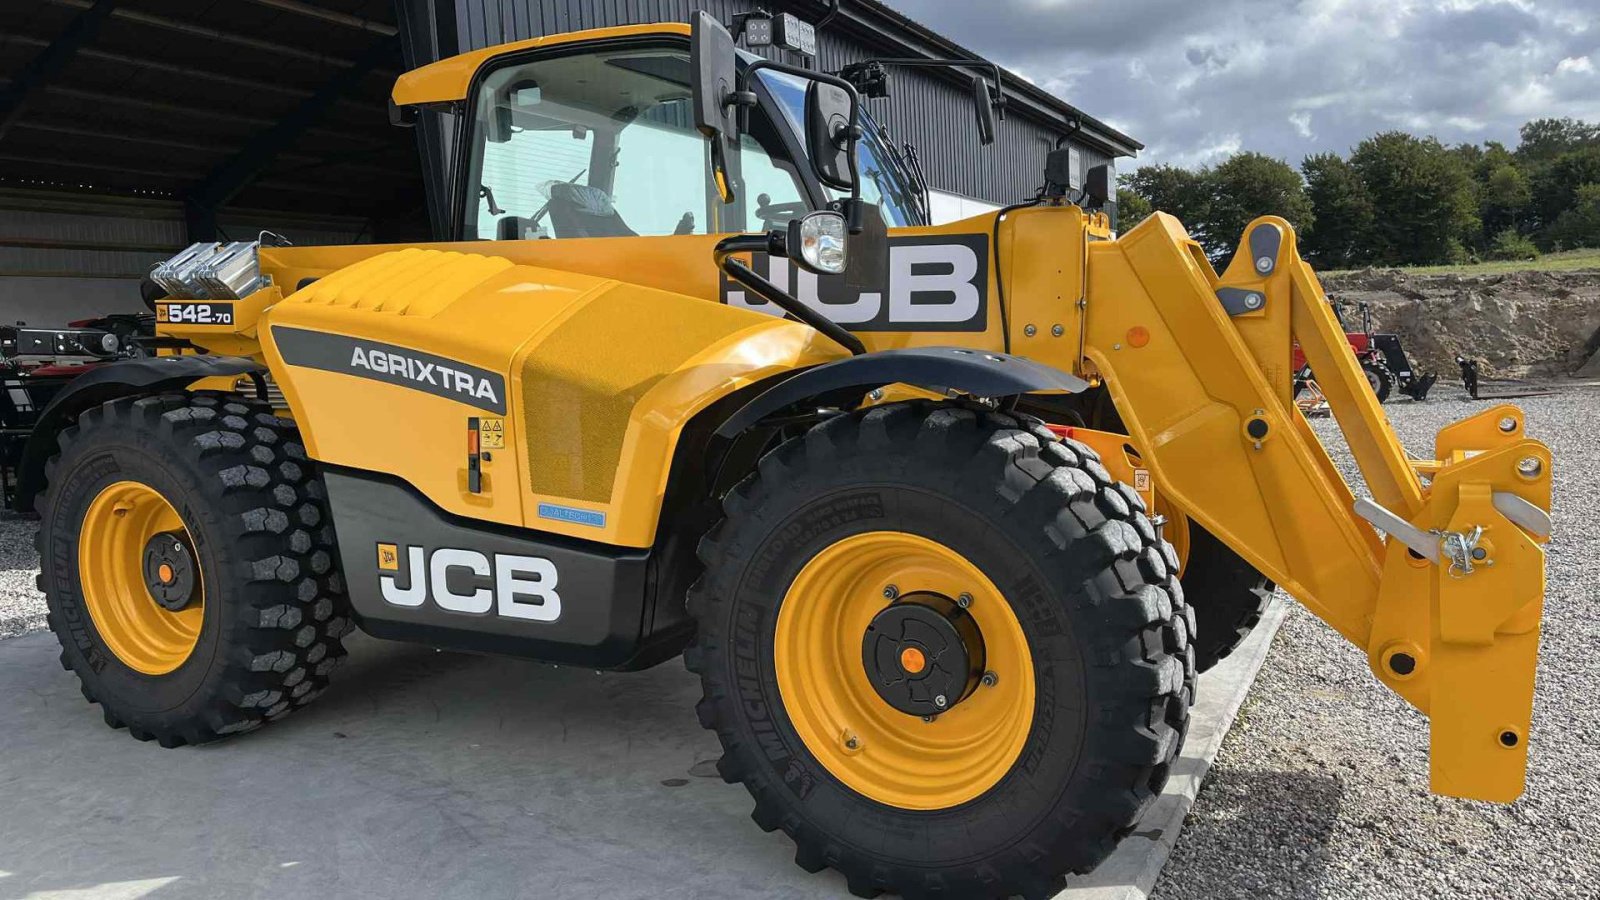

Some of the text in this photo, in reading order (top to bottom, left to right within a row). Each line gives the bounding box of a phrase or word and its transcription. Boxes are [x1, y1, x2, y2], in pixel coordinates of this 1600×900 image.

[350, 346, 498, 404] AGRIXTRA
[54, 535, 92, 650] MICHELIN
[380, 546, 562, 622] JCB
[736, 603, 790, 762] MICHELIN
